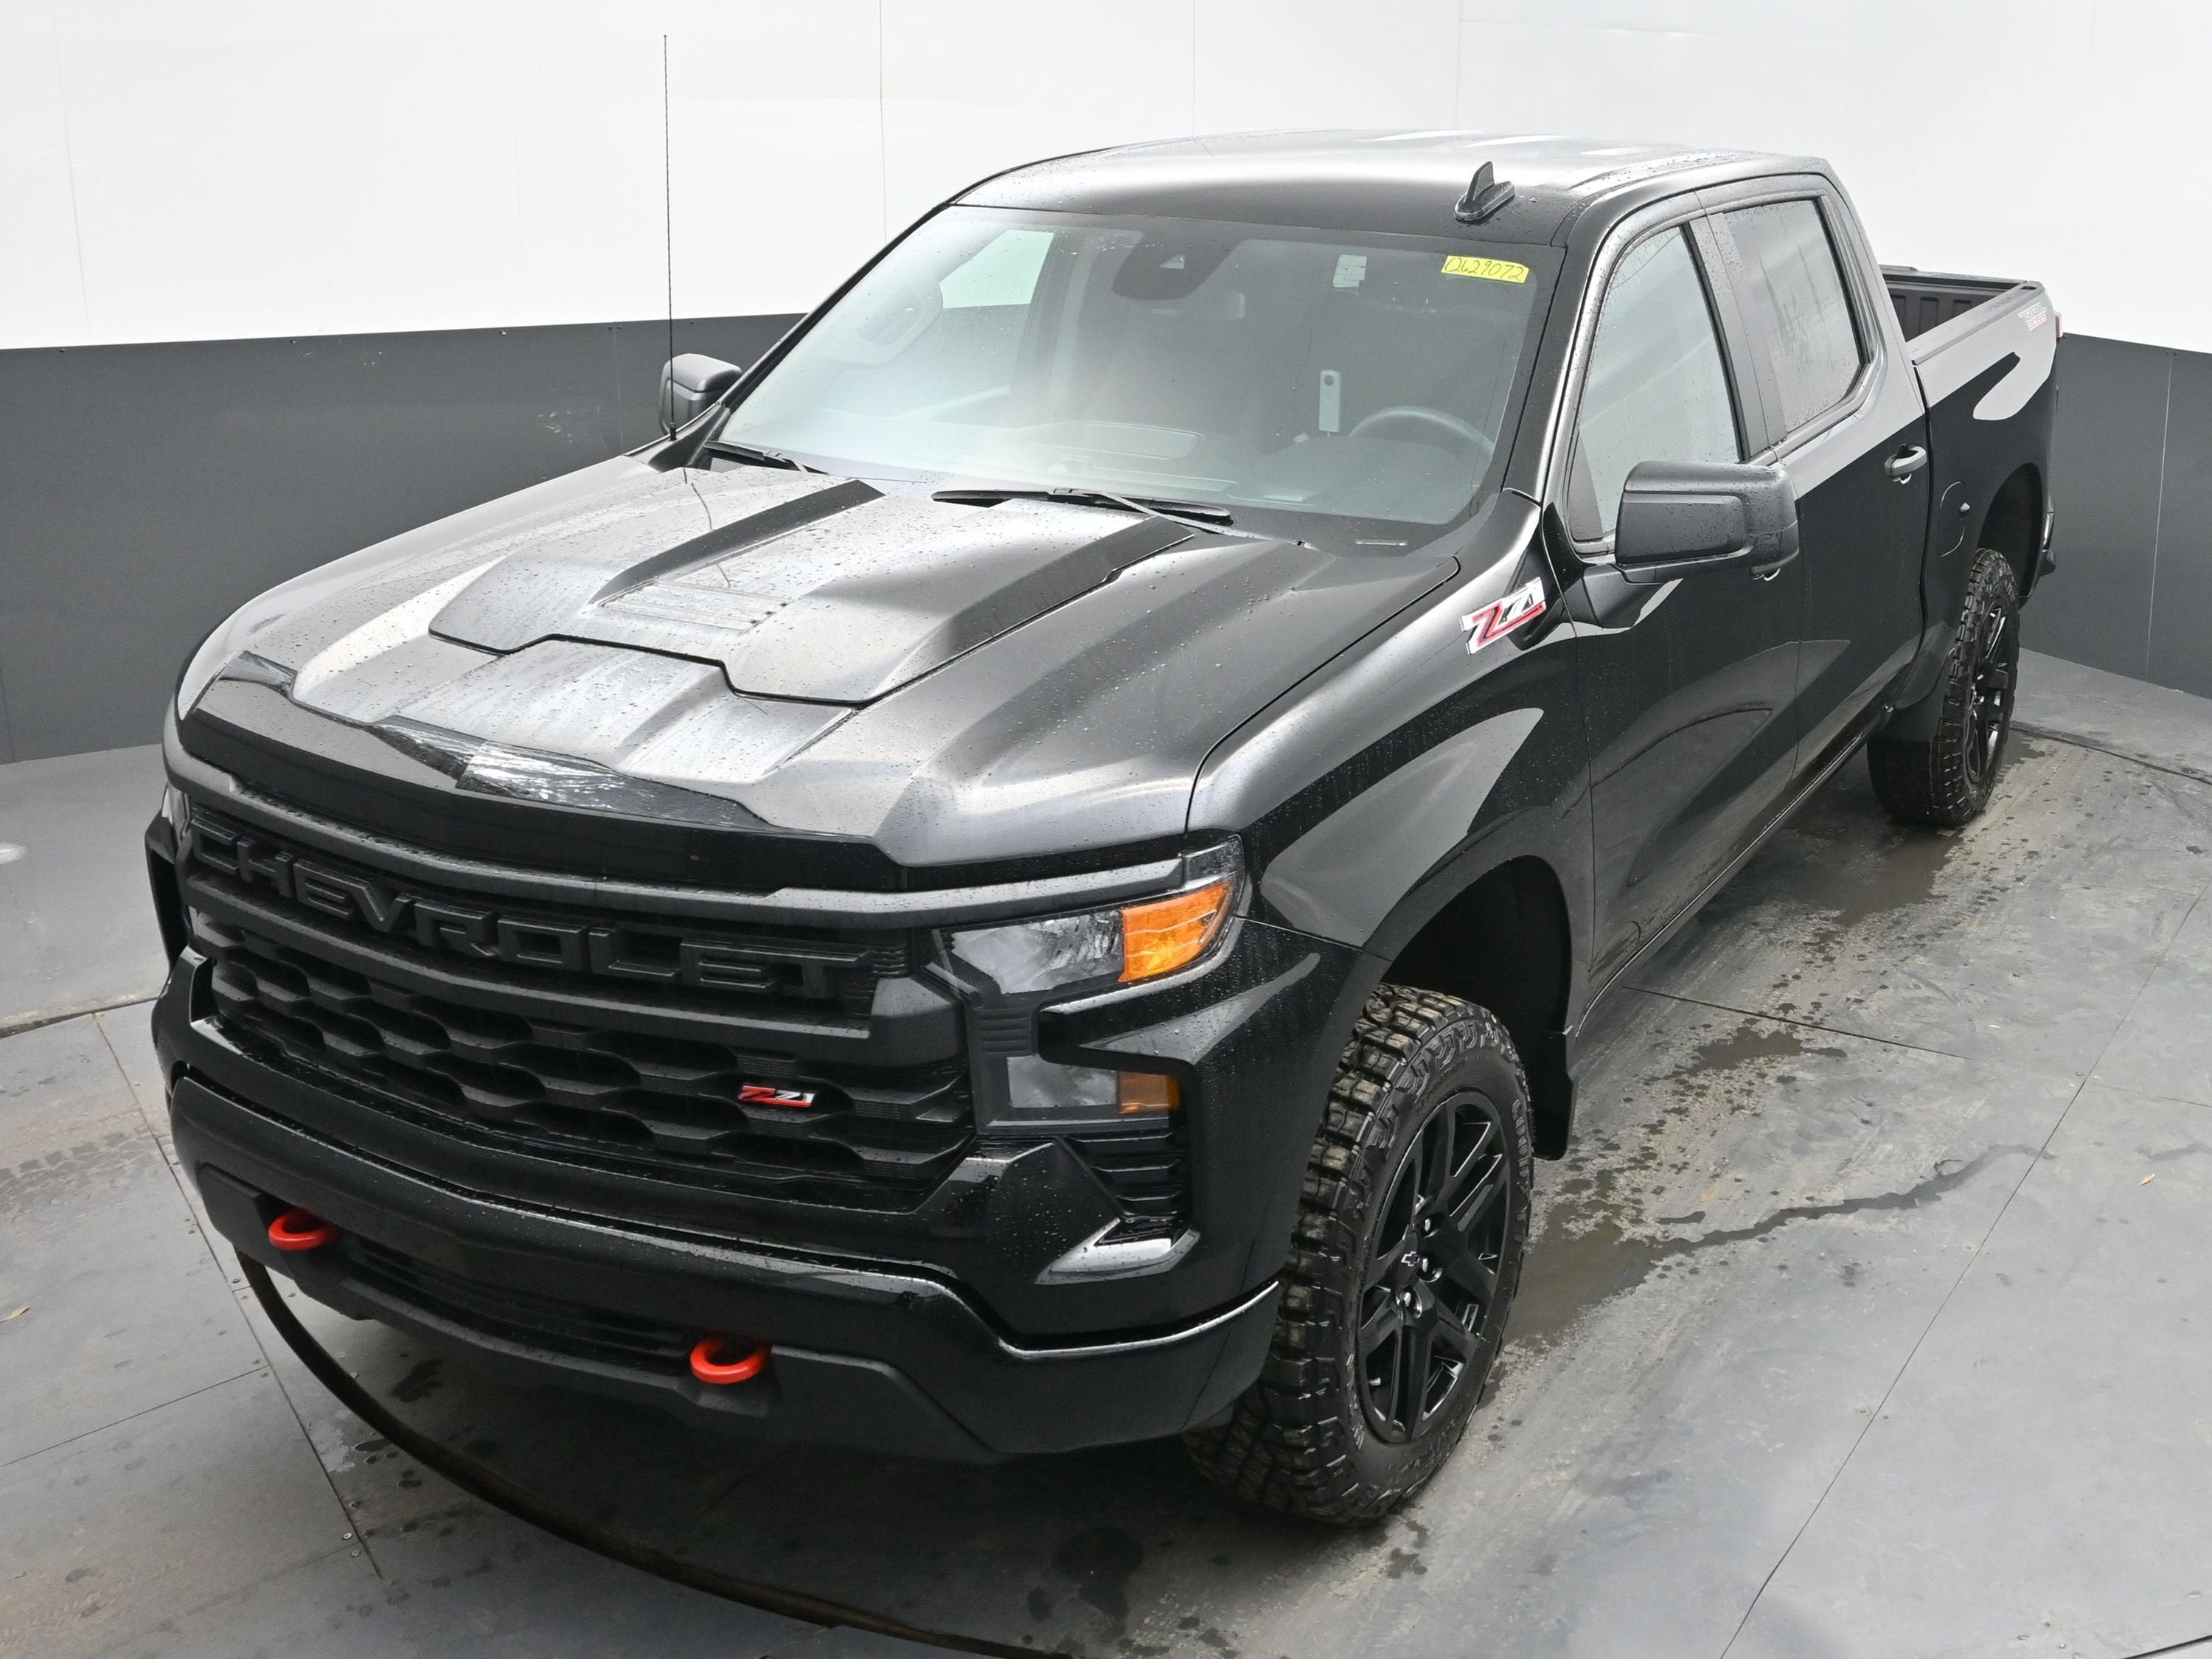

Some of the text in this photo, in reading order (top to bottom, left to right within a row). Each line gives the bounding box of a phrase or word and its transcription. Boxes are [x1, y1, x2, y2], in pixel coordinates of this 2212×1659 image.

[1459, 577, 1546, 655] Z71
[190, 816, 869, 998] CHEVROLET
[737, 1085, 815, 1107] Z71
